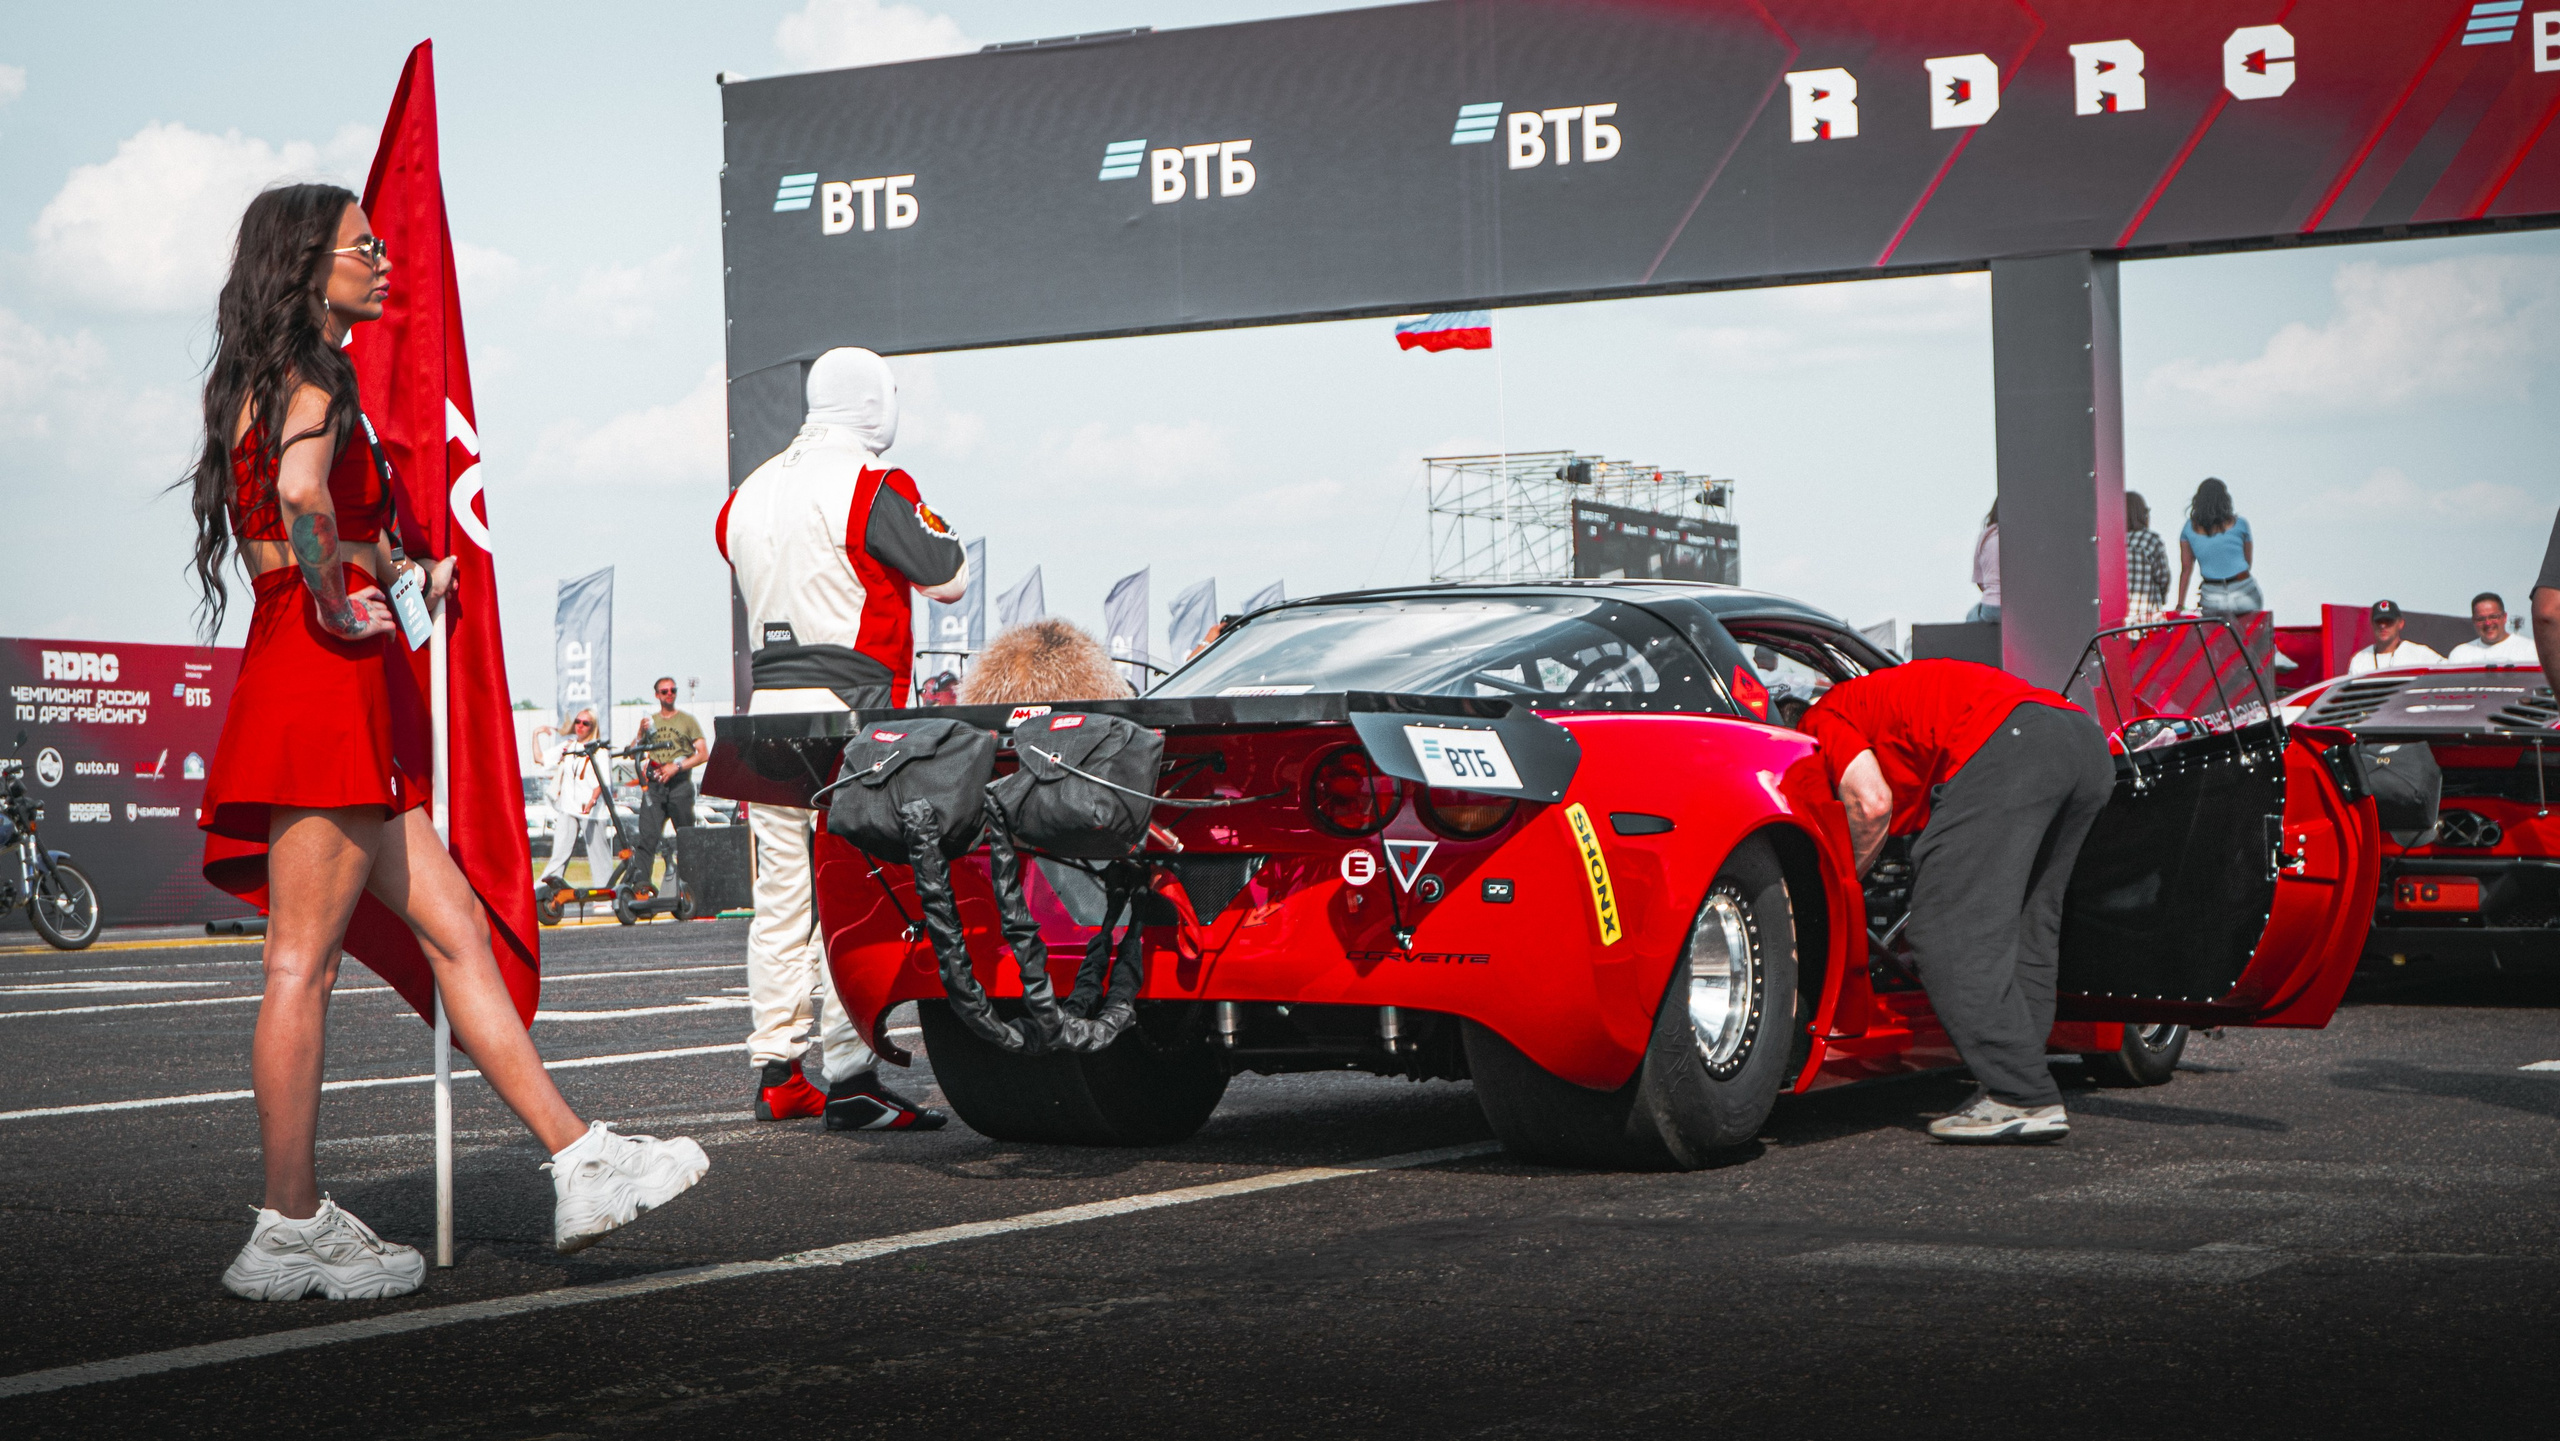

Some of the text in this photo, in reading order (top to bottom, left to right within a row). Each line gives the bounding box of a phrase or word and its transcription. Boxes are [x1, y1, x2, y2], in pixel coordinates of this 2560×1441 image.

[1508, 102, 1622, 169] ВТБ
[1150, 139, 1257, 204] ВТБ
[821, 173, 919, 236] ВТБ
[42, 650, 119, 682] RDRC
[11, 685, 150, 706] ЧЕМПИОНАТ РОССИИ
[185, 687, 212, 707] ВТБ
[16, 702, 147, 724] ПО ДРЭГ-РЕЙСИНГУ
[75, 761, 119, 775] auto.ru
[1445, 747, 1497, 777] ВТБ
[137, 806, 180, 818] ЧЕМПИОНАТ
[1349, 857, 1369, 876] E
[1573, 811, 1617, 938] SHONX
[1346, 950, 1491, 964] CORVETTE
